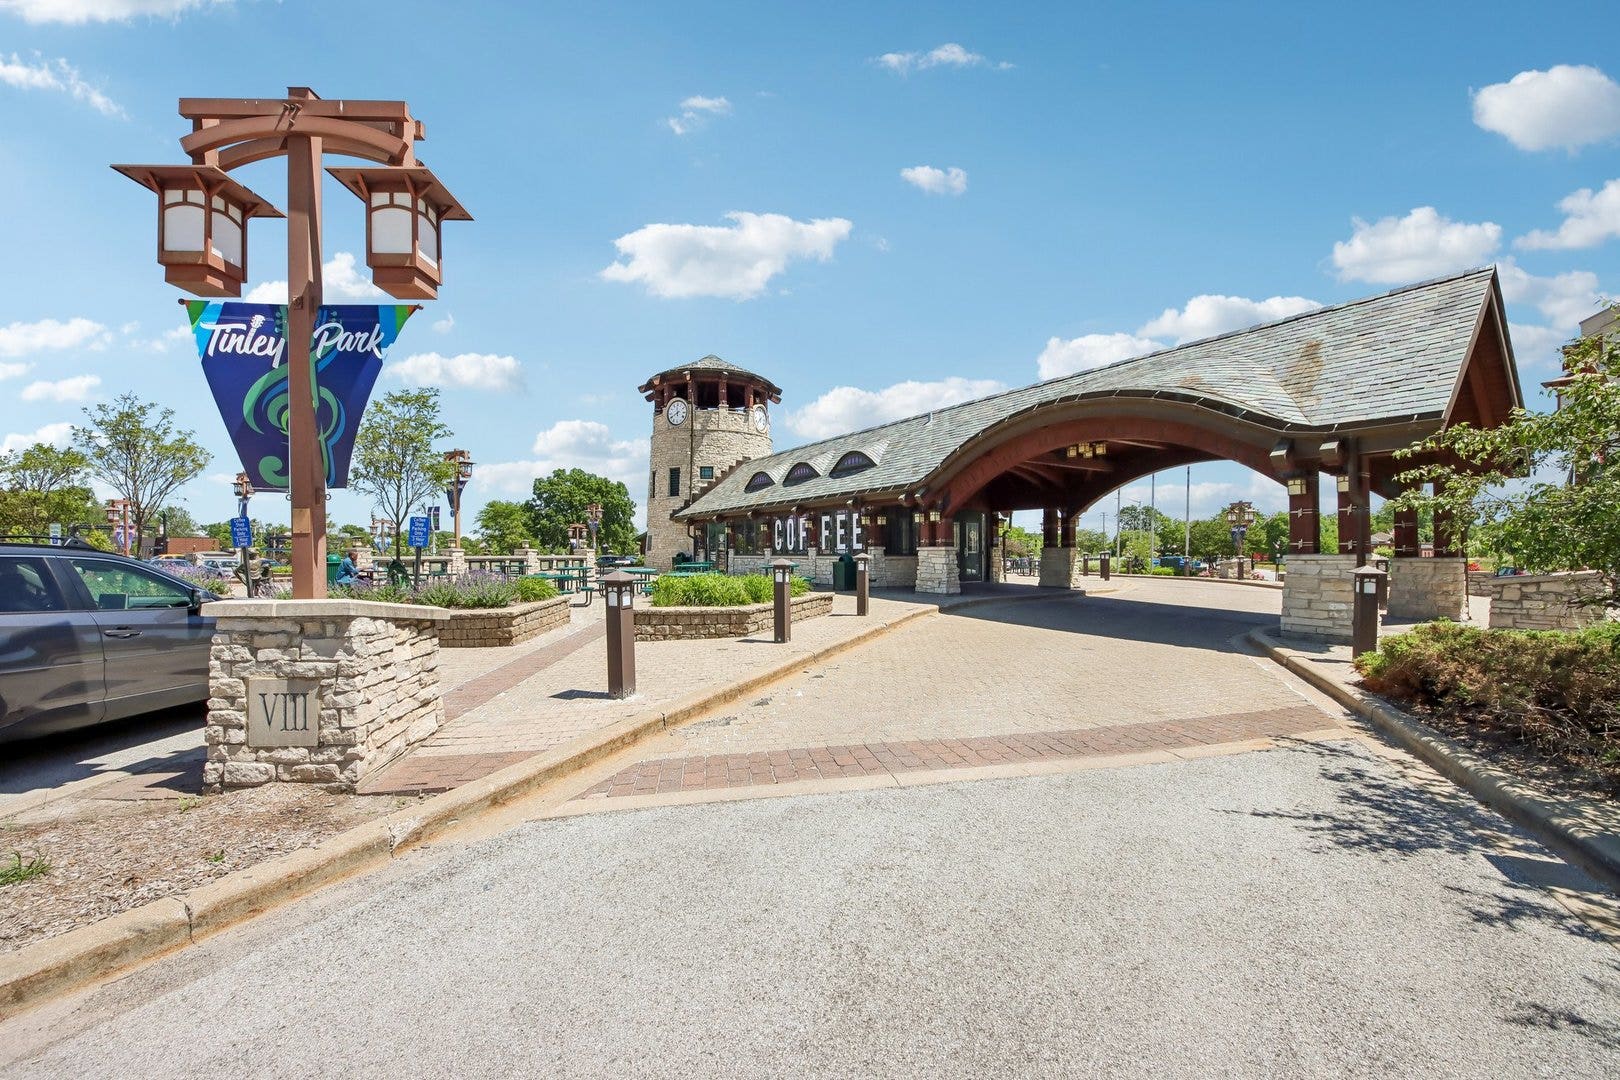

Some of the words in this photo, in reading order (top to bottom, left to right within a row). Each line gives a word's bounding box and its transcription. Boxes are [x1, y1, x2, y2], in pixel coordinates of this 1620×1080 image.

[200, 314, 285, 369] Tinley
[313, 322, 384, 359] Park
[258, 692, 310, 732] VIII
